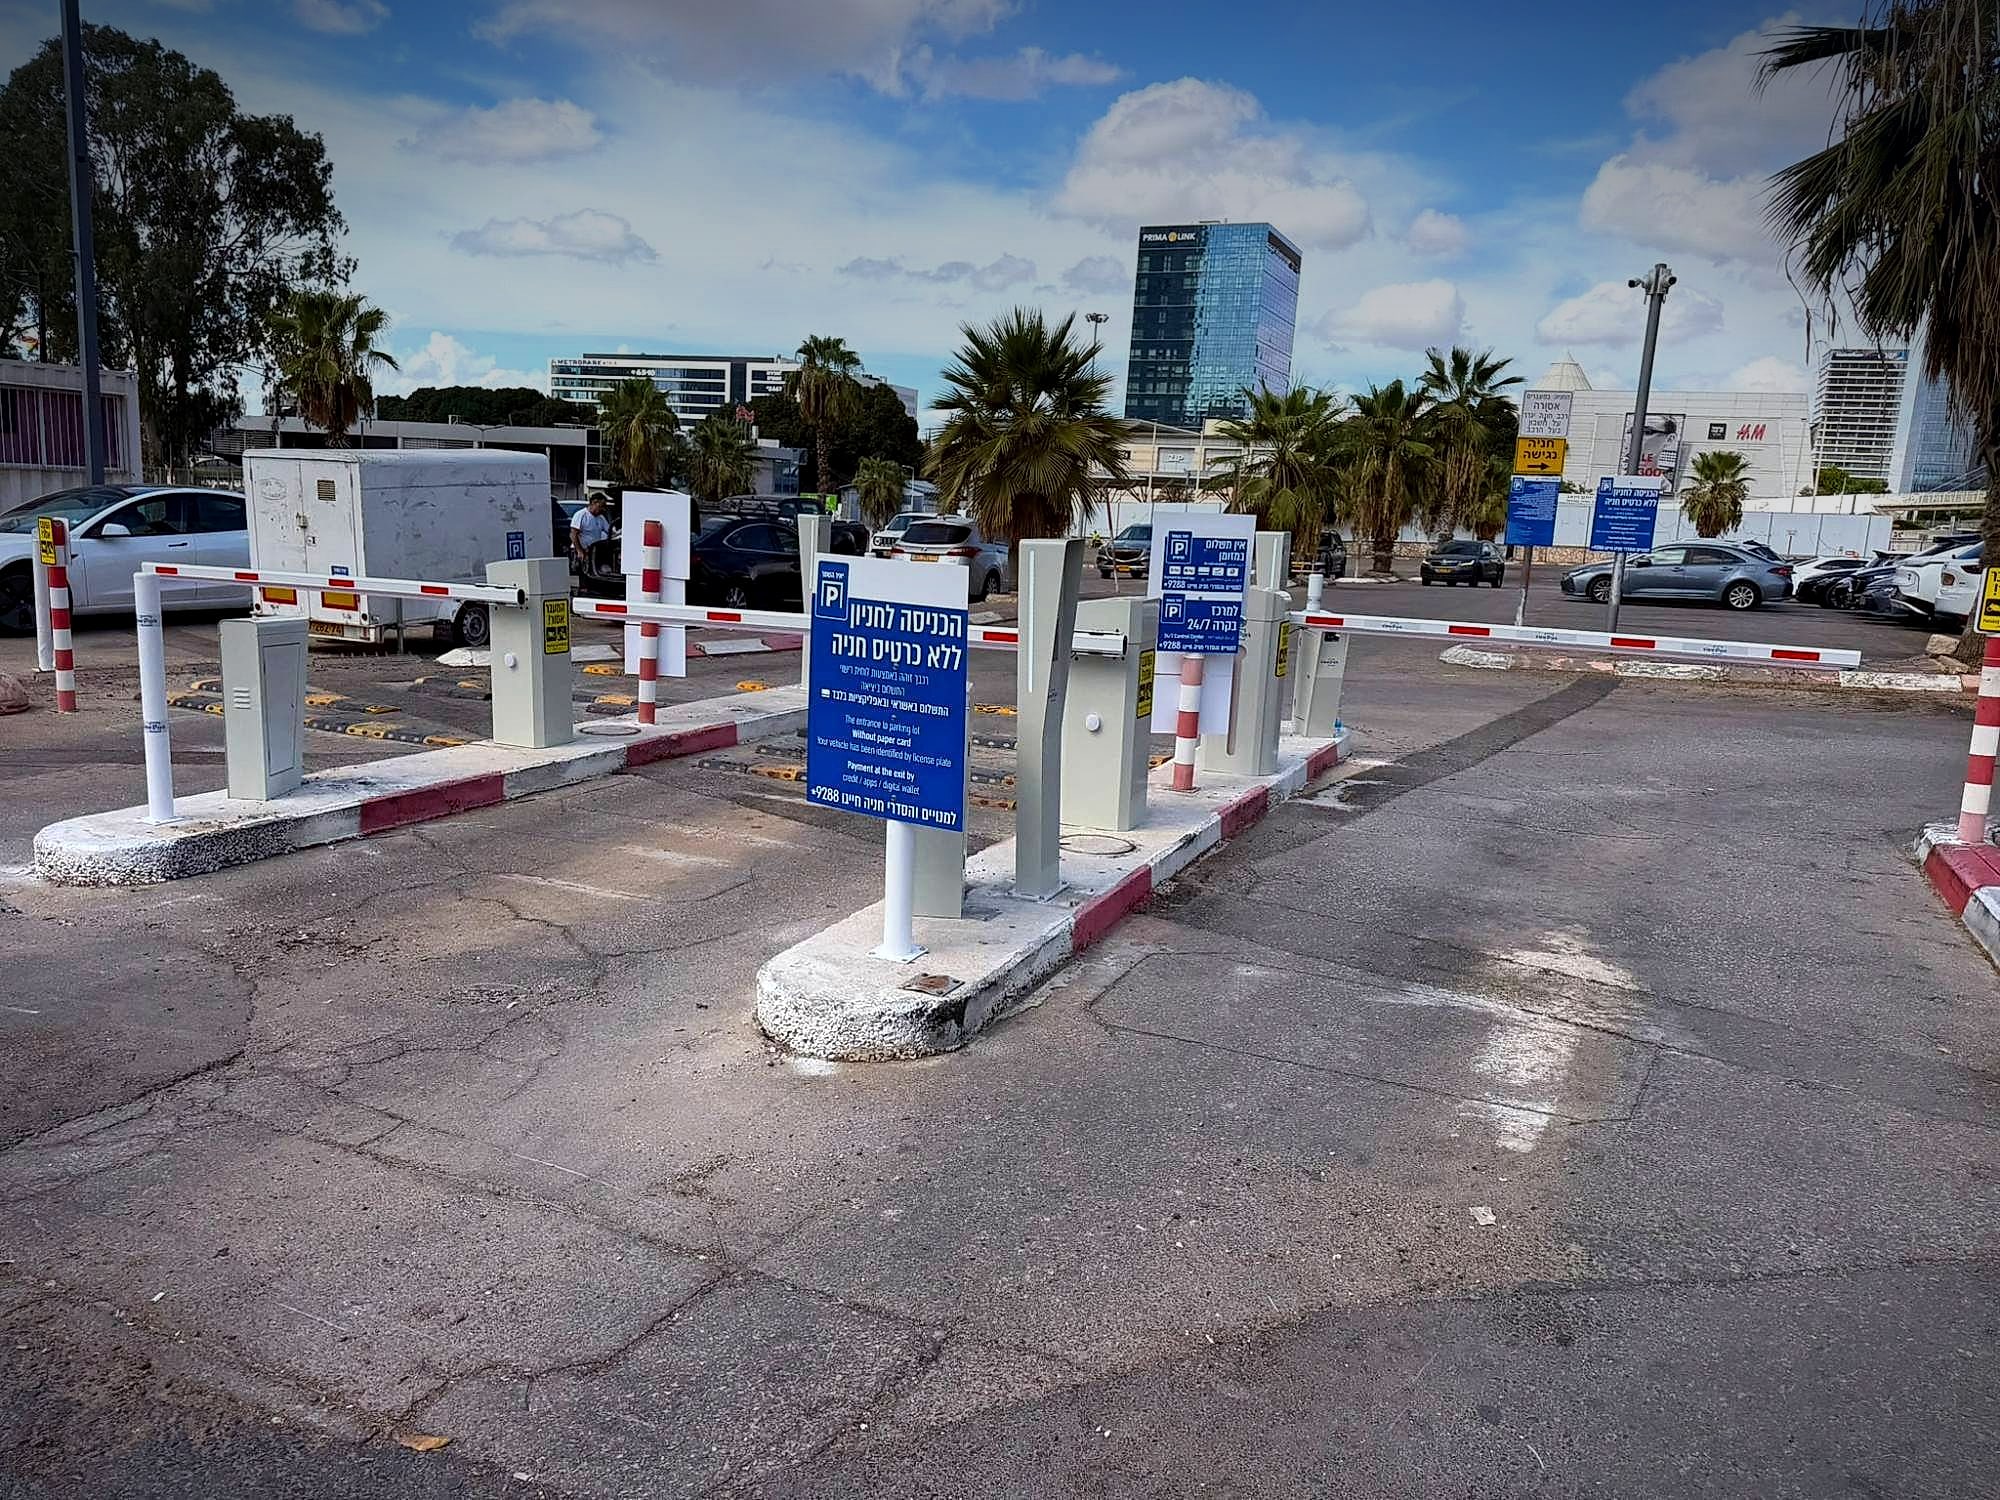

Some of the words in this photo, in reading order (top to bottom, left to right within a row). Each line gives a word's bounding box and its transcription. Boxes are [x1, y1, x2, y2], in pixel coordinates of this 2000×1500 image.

[1143, 233, 1168, 241] PRIMA
[1533, 402, 1560, 411] אסורה
[1736, 424, 1767, 441] H&M
[1528, 439, 1555, 448] חניה
[1523, 450, 1558, 460] נגישה
[1206, 539, 1232, 550] תשלום
[1234, 540, 1246, 551] אין
[1219, 551, 1245, 562] במזומן
[850, 603, 895, 630] לחניון
[1211, 604, 1239, 617] למרכז
[900, 608, 962, 638] הכניסה
[1186, 618, 1211, 631] 24/7
[1212, 619, 1238, 632] בקרה
[832, 633, 866, 658] חניה
[872, 638, 922, 666] כרטיס
[927, 645, 962, 671] ללא
[831, 690, 847, 701] בלבד
[848, 693, 889, 708] ובאפליקציות
[890, 699, 918, 713] באשראי
[919, 703, 949, 717] התשלום
[845, 714, 855, 723] The
[855, 716, 882, 729] entrance
[882, 720, 889, 730] to
[889, 722, 911, 735] parking
[911, 726, 920, 735] lot
[852, 729, 876, 741] Without
[877, 734, 895, 747] paper
[896, 737, 912, 747] card
[816, 736, 828, 746] Your
[829, 738, 849, 750] vehicle
[849, 741, 860, 752] has
[860, 743, 875, 755] been
[875, 745, 904, 760] identified
[904, 750, 912, 763] by
[912, 752, 935, 765] license
[935, 757, 952, 768] plate
[847, 760, 874, 774] Payment
[874, 765, 881, 774] at
[881, 766, 893, 777] the
[893, 768, 906, 779] exit
[906, 770, 915, 782] by
[842, 774, 858, 784] credit
[863, 777, 878, 788] apps
[882, 779, 900, 792] digital
[901, 783, 920, 795] wallet
[863, 796, 885, 813] חניה
[887, 801, 919, 819] והסדרי
[921, 807, 957, 826] למנויים
